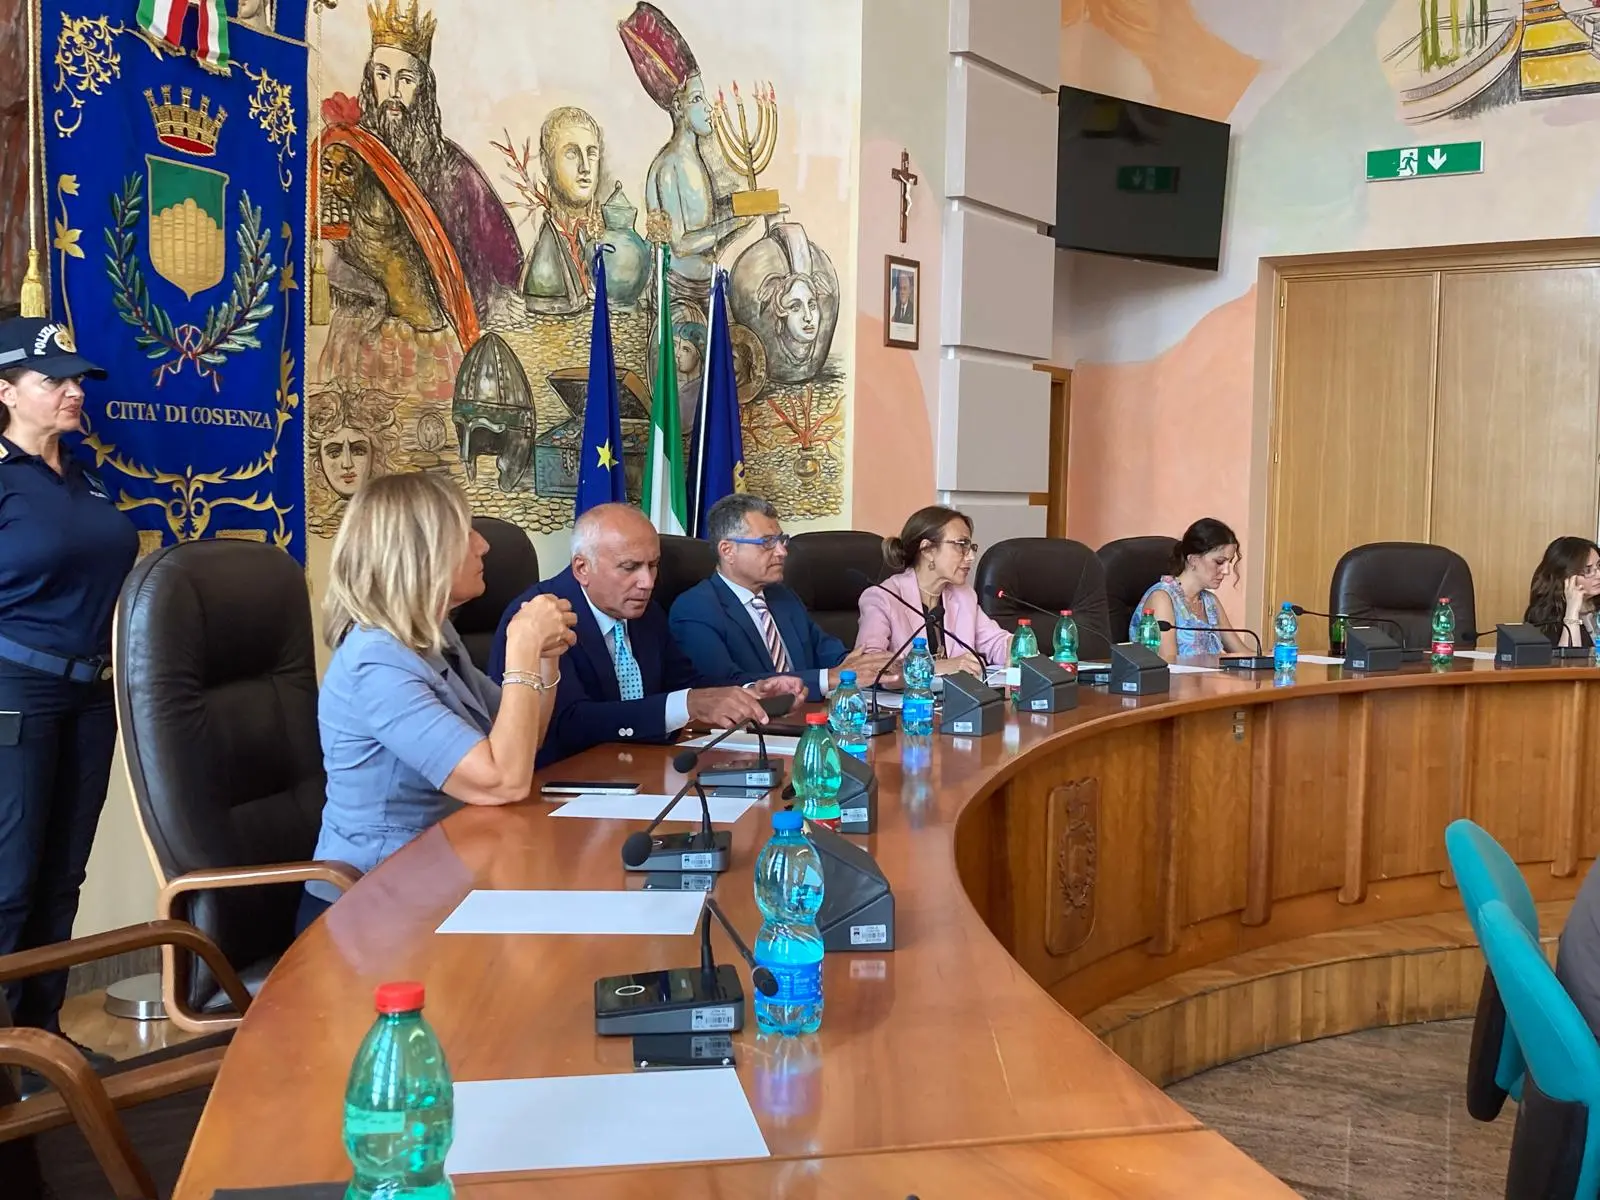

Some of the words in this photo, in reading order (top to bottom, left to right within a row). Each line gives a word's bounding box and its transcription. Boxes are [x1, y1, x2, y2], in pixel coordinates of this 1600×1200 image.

[34, 324, 58, 355] POLIZIA
[106, 401, 160, 421] CITTA'
[164, 405, 188, 423] DI
[191, 406, 272, 429] COSENZA
